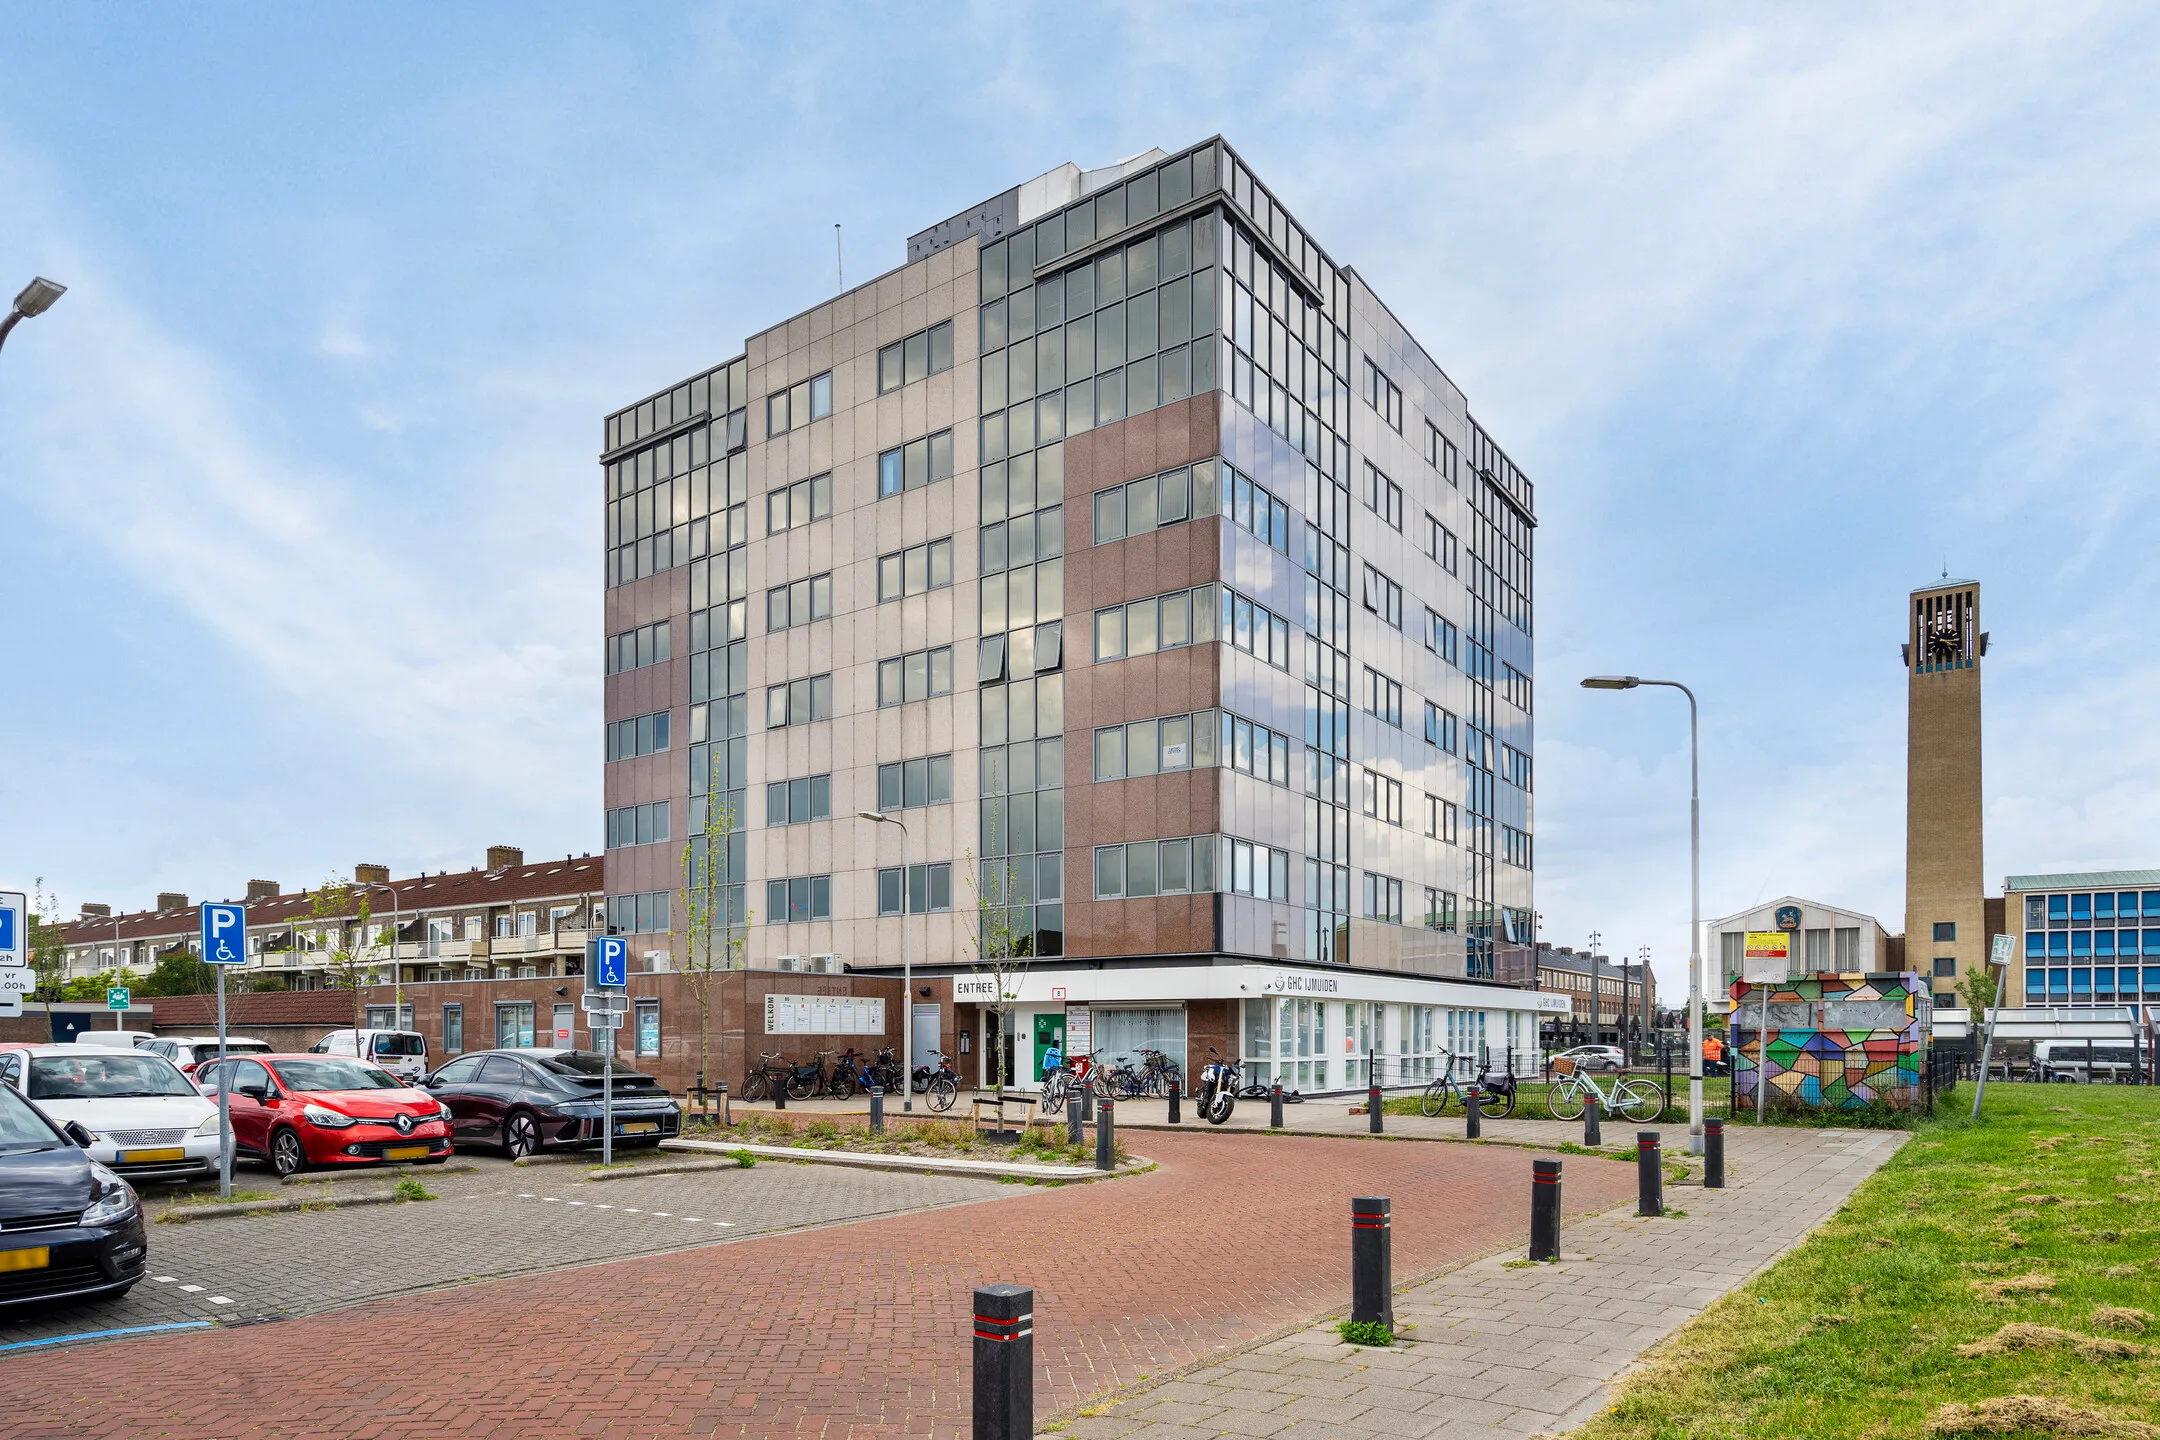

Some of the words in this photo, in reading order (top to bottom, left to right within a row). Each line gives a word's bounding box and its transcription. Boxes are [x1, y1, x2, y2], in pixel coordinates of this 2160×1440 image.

[212, 909, 235, 938] P
[605, 941, 620, 965] P
[957, 982, 993, 993] ENTREE
[1287, 976, 1302, 990] GHC
[1305, 978, 1338, 992] IJMUIDEN
